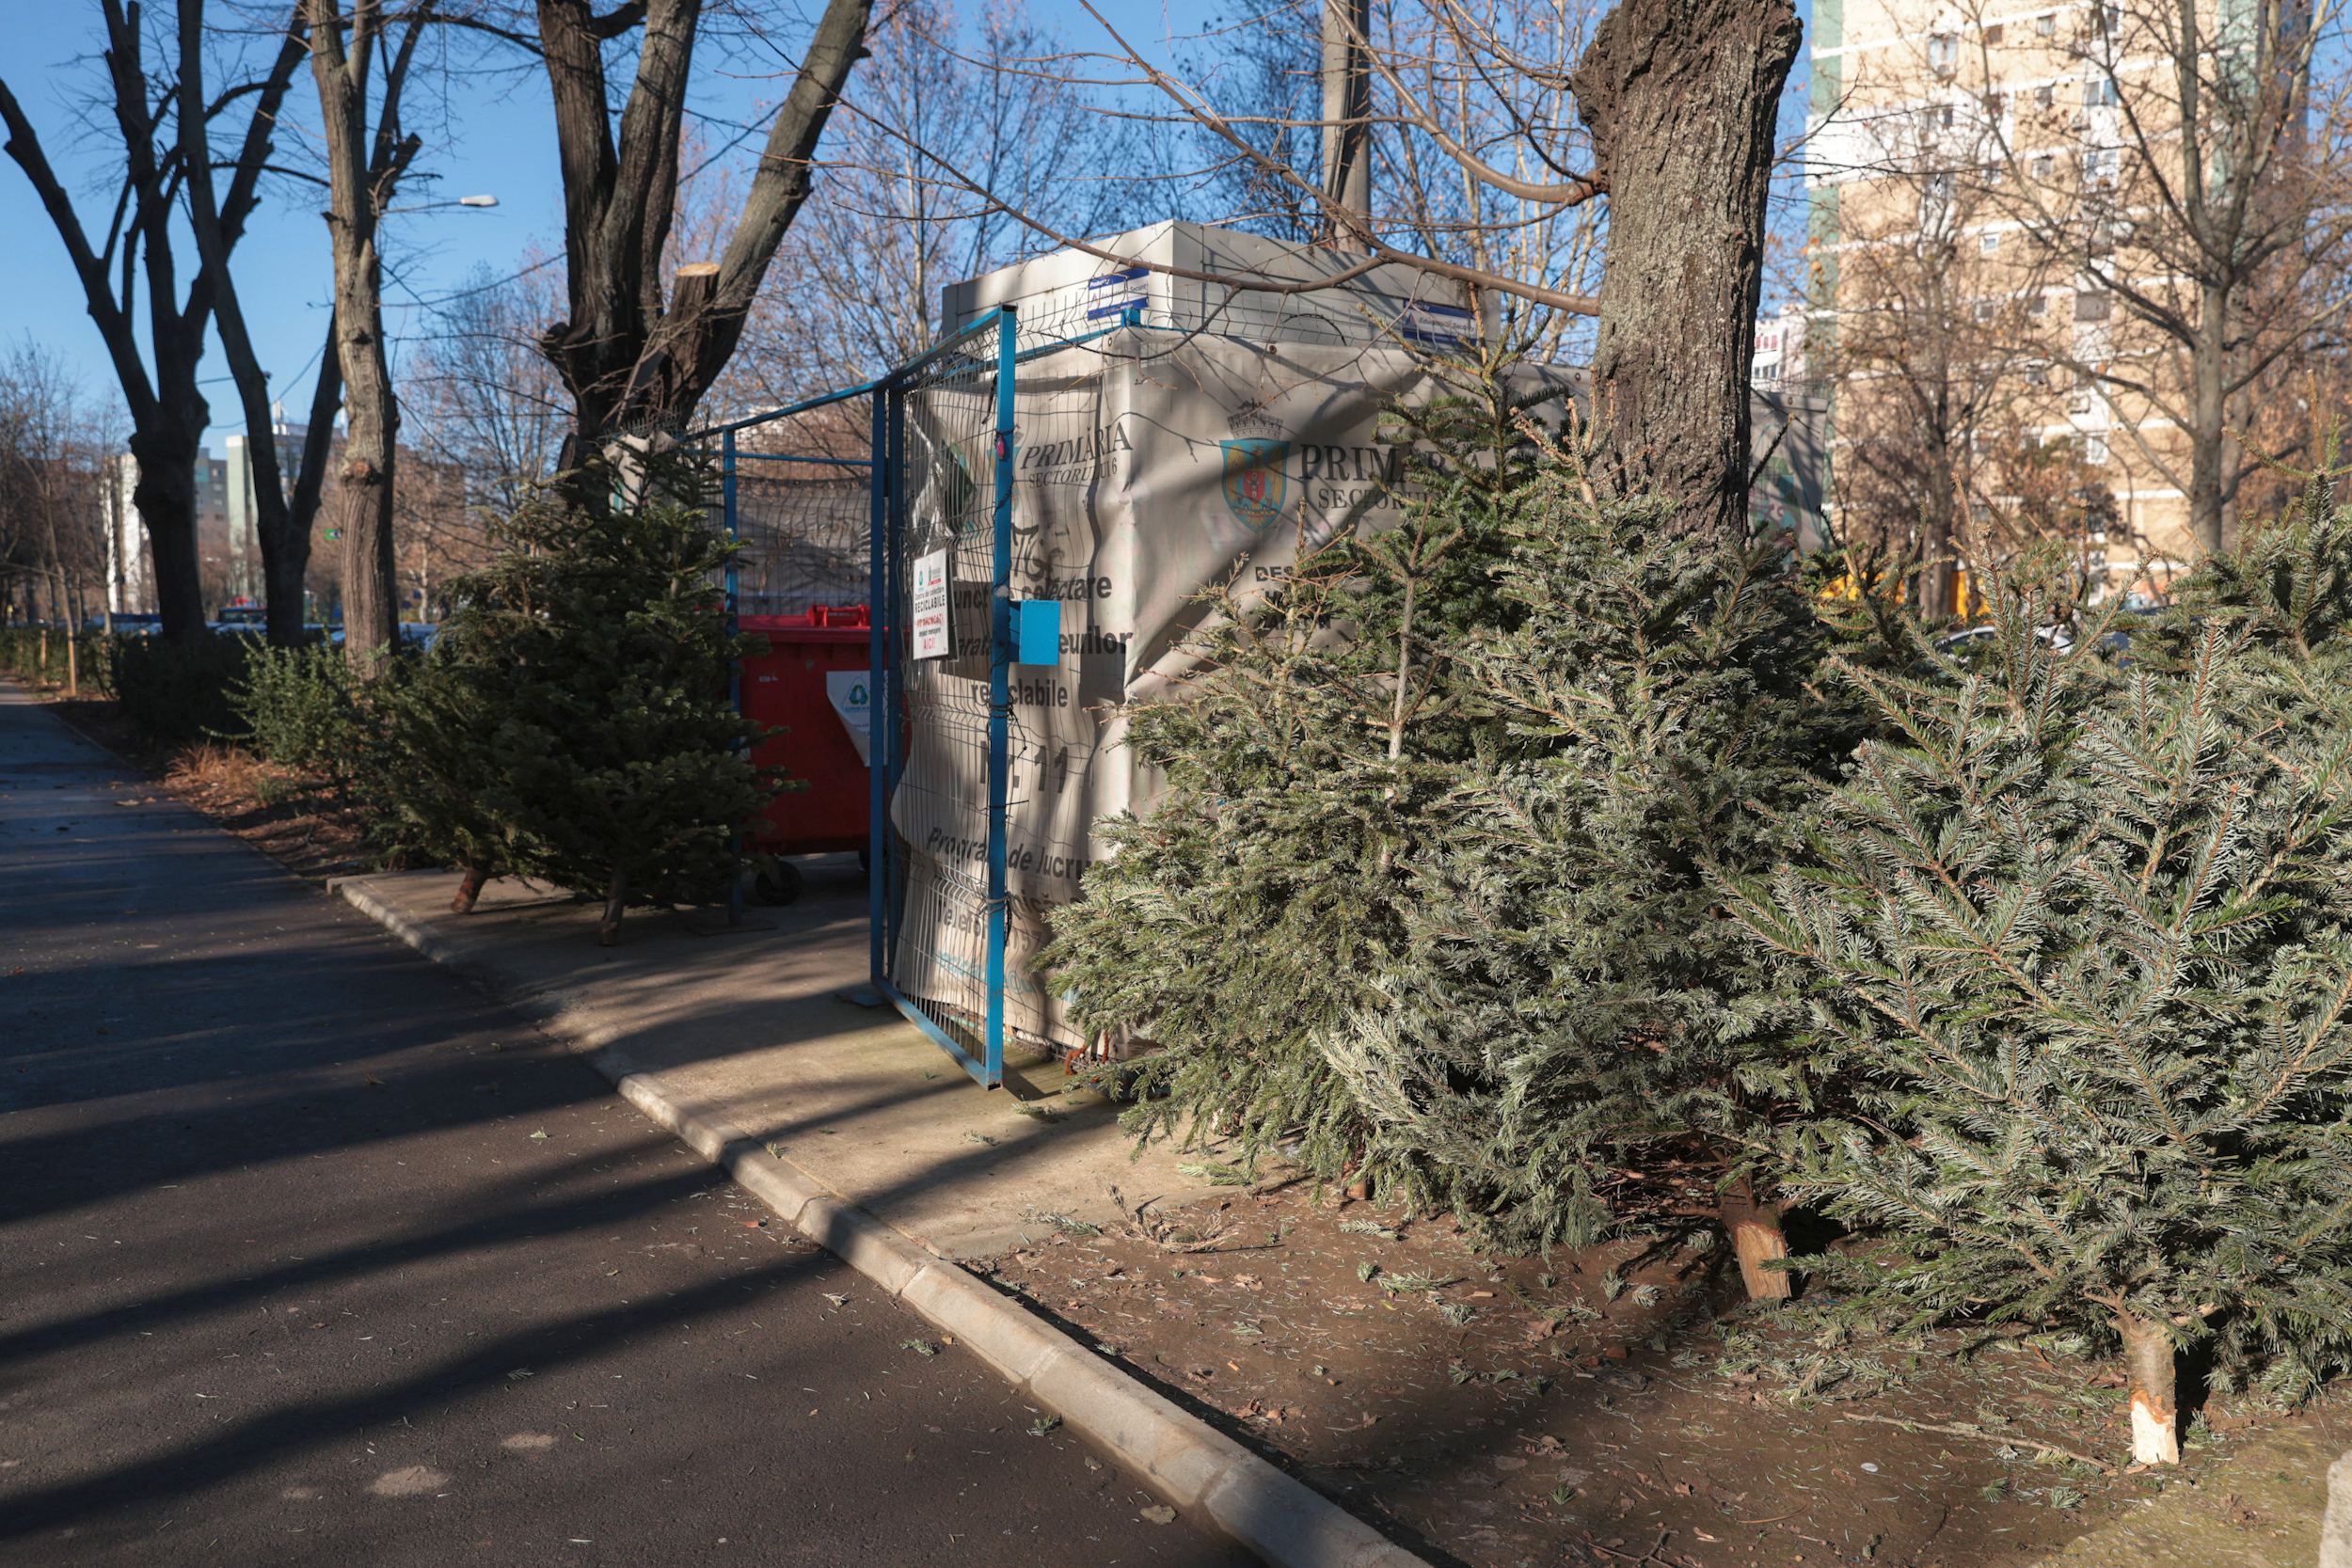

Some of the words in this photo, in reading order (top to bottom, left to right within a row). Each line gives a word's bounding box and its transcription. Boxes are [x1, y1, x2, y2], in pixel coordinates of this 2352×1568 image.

[1020, 422, 1134, 469] PRIMĂRIA
[1028, 461, 1110, 489] SECTORULUI
[1112, 457, 1118, 475] 6
[914, 594, 946, 613] RECICLABILE
[954, 583, 989, 610] unct
[924, 637, 935, 650] AICI!
[1058, 625, 1134, 656] eurilor
[1034, 744, 1068, 793] 11
[926, 827, 989, 864] Progra
[1008, 843, 1033, 871] de
